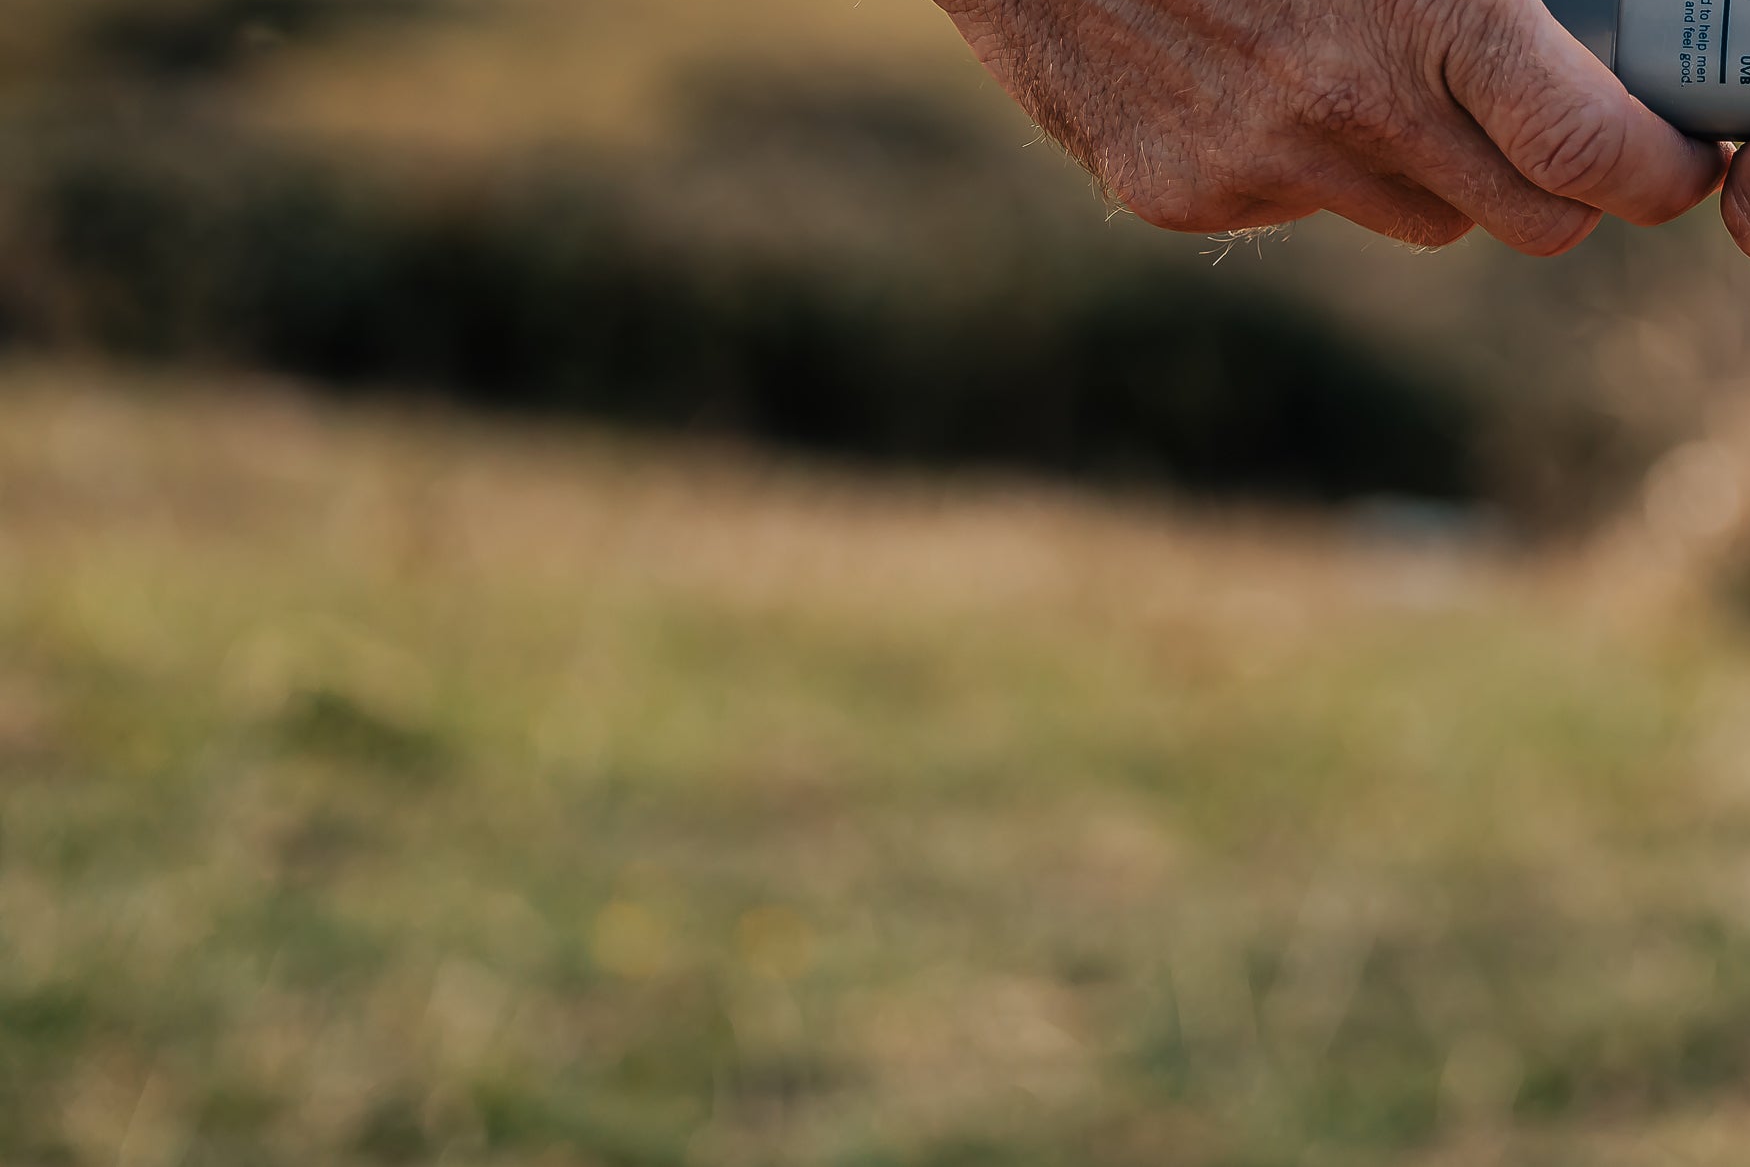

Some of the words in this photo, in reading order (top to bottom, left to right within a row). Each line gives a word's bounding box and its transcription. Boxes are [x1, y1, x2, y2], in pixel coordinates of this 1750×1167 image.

[1684, 0, 1695, 23] and
[1700, 9, 1711, 20] to
[1682, 27, 1695, 49] feel
[1696, 24, 1711, 51] help
[1680, 53, 1692, 88] good.
[1696, 55, 1706, 83] men
